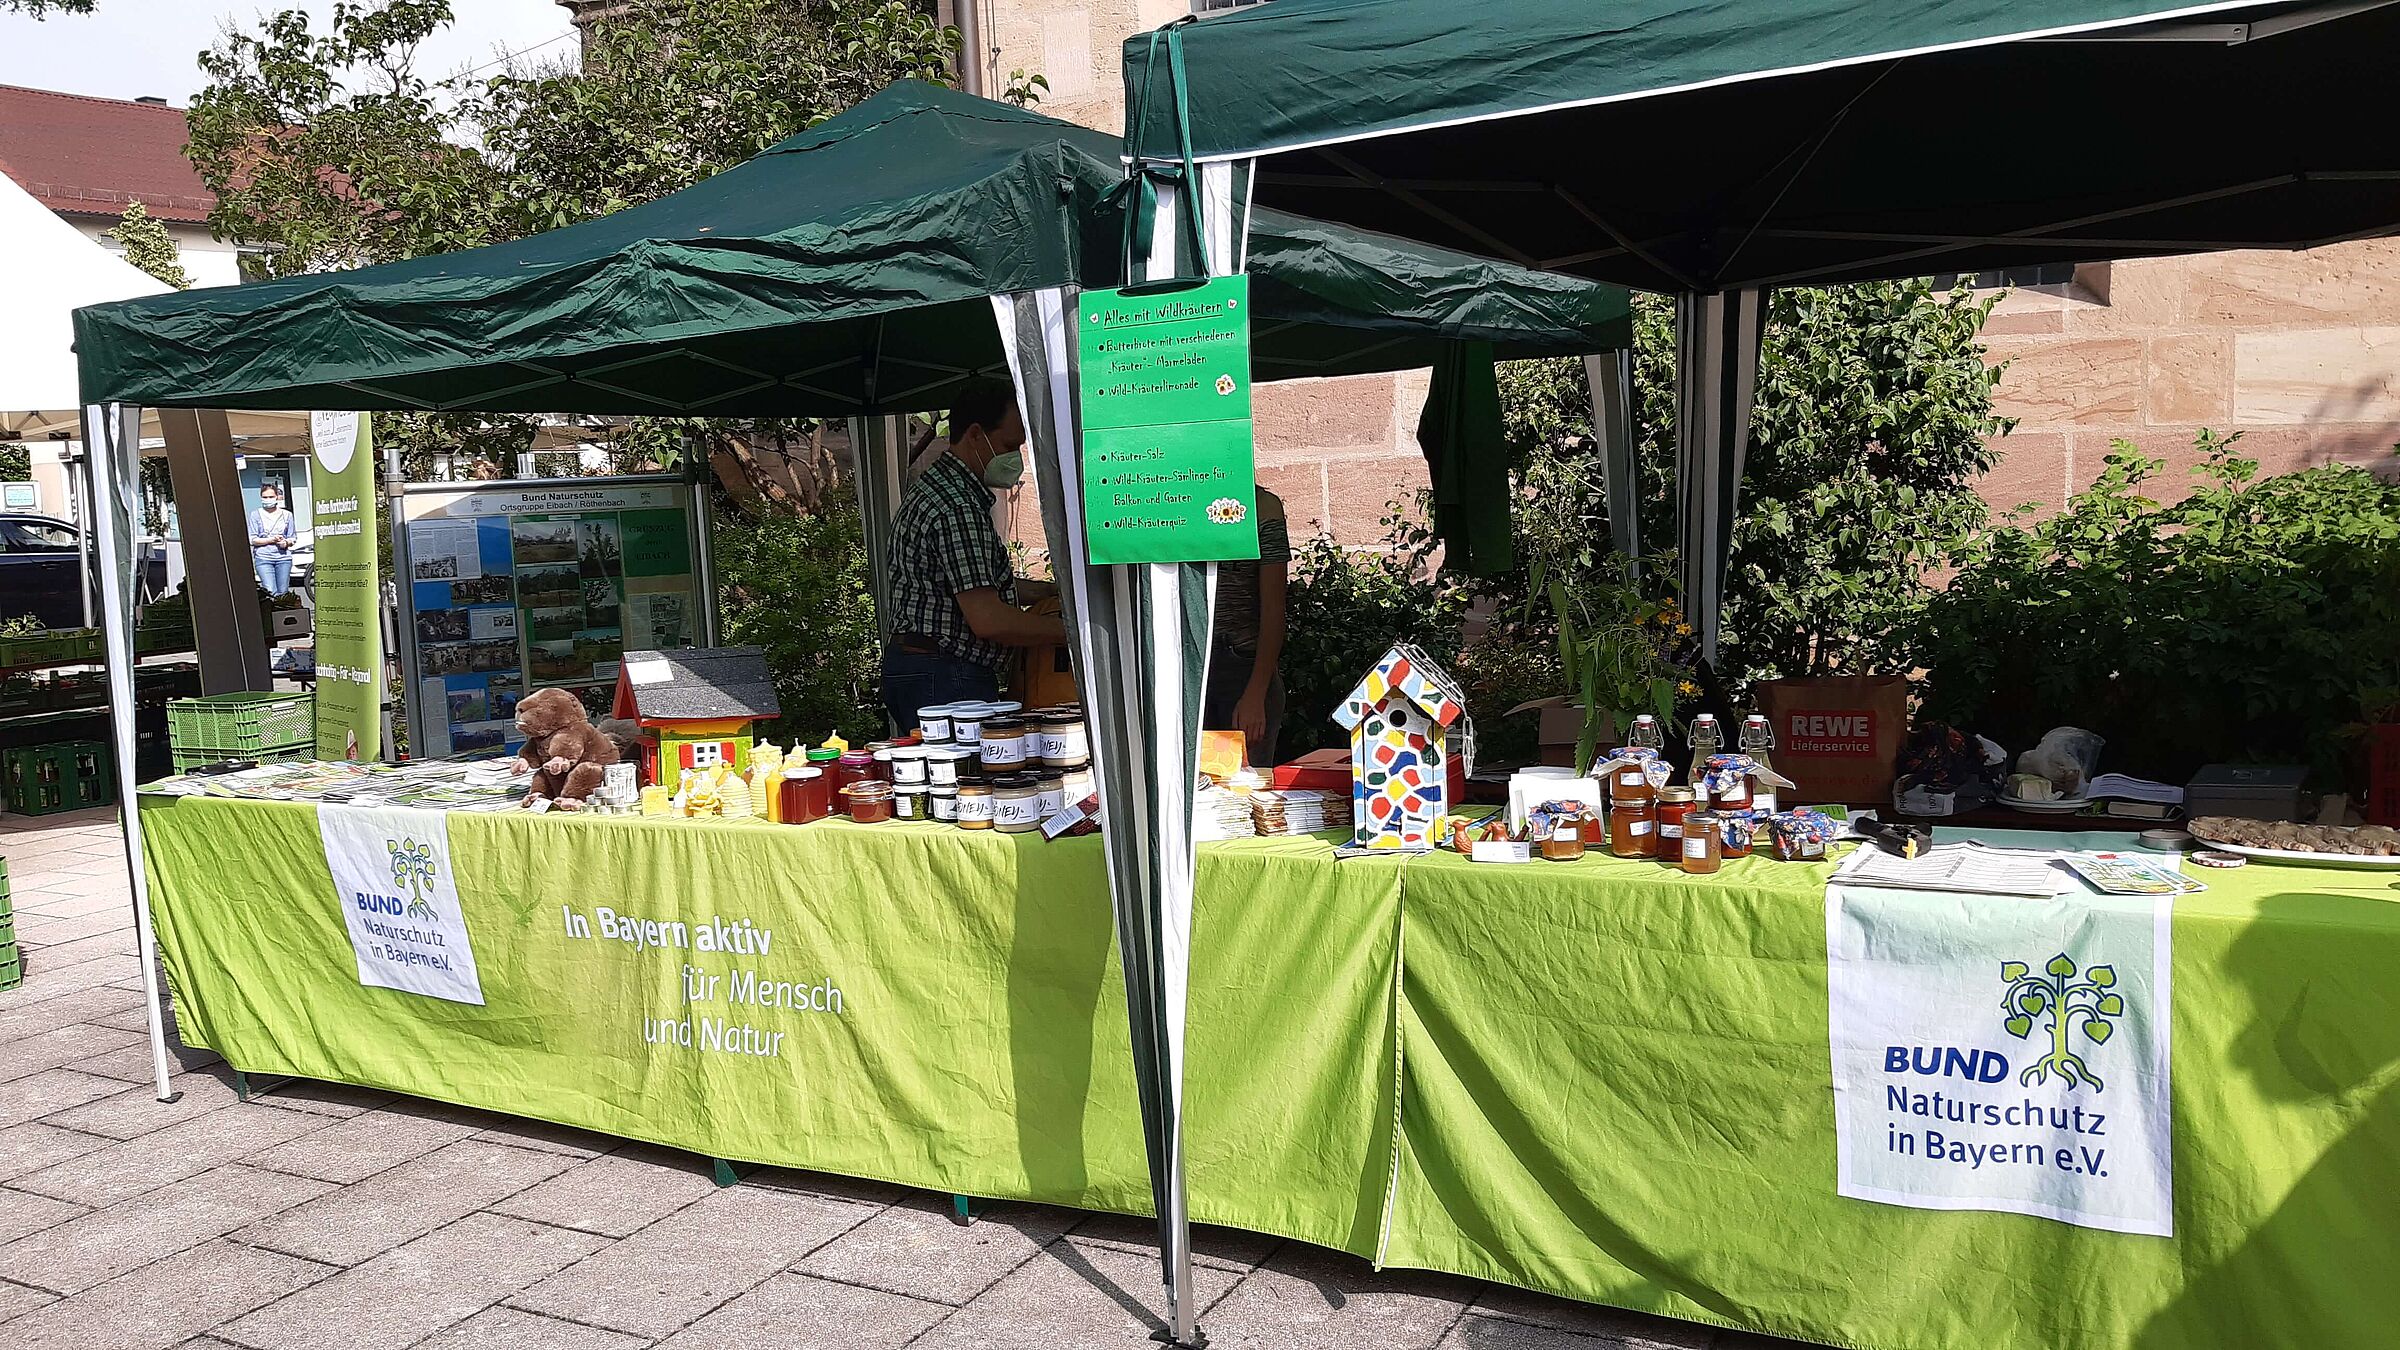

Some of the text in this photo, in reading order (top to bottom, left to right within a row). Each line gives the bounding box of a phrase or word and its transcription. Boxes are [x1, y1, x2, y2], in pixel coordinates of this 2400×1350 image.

[1104, 302, 1222, 326] Alles mit Wildkräutern
[1107, 329, 1236, 352] Butterbrote mit verschiedenen
[1108, 377, 1199, 396] Wild-Kräuterlimonade
[1110, 448, 1165, 462] Kräuter-Salz
[1112, 467, 1227, 486] Wild-Kräuter-Sämlinge für
[500, 503, 544, 512] Ortsgruppe
[546, 501, 573, 510] Eibach
[580, 499, 626, 508] Röthenbach
[522, 491, 604, 502] Bund Naturschutz
[1114, 492, 1192, 506] Balkon und Garten
[1114, 516, 1187, 531] Wild-Kräuterquiz
[1792, 716, 1869, 738] REWE
[1792, 740, 1870, 752] Lieferservice
[356, 892, 403, 916] BUND
[363, 918, 446, 947] Naturschutz
[562, 904, 772, 956] In Bayern aktiv
[370, 941, 453, 972] in Bayern e.V.
[682, 964, 842, 1014] für Mensch
[644, 1014, 784, 1057] und Natur
[1884, 1046, 2010, 1084] BUND
[1886, 1085, 2106, 1136] Naturschutz
[1888, 1122, 2108, 1178] in Bayern e.V.
